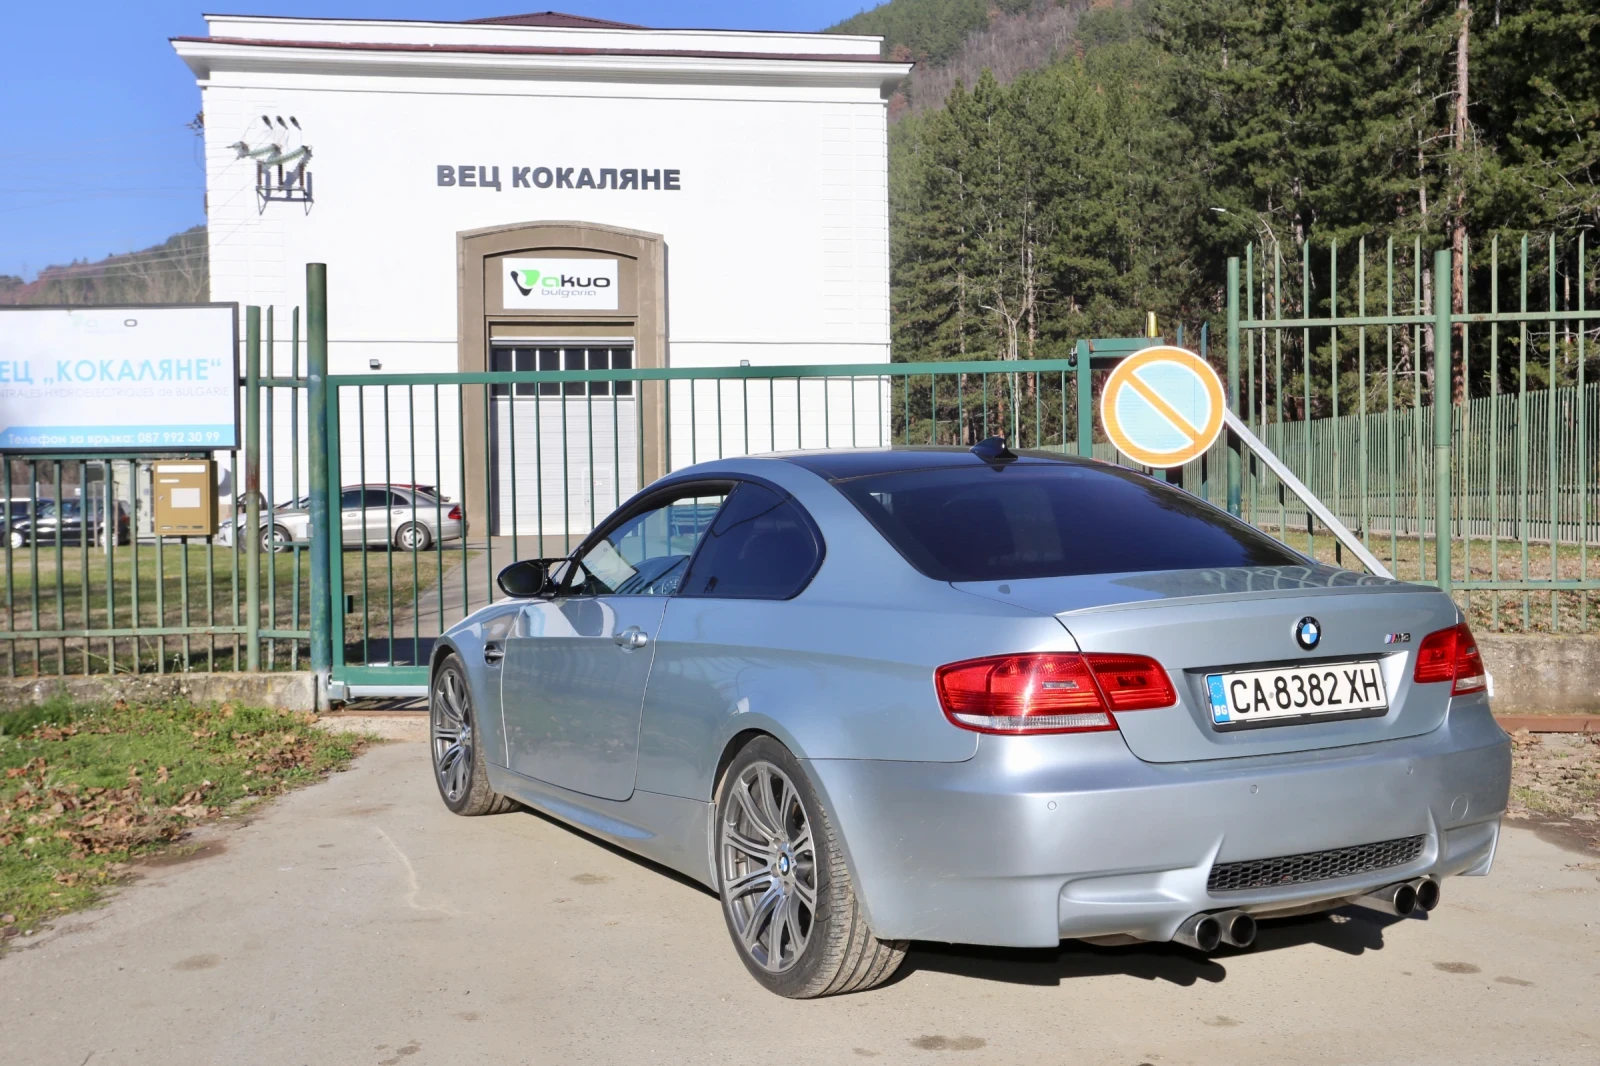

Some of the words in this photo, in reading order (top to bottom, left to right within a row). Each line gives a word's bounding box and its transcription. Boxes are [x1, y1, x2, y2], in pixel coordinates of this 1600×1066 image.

[436, 164, 502, 192] ВЕЦ
[511, 166, 682, 191] КОКАЛЯНЕ
[541, 274, 611, 288] akuo
[541, 288, 597, 298] bulgaria
[158, 386, 173, 397] de
[176, 386, 229, 397] BULGARIE
[69, 435, 85, 444] за
[138, 432, 159, 443] 087
[163, 432, 184, 443] 992
[187, 432, 203, 443] 30
[205, 431, 220, 442] 99
[1230, 677, 1270, 713] CA
[1274, 671, 1342, 709] 8382
[1343, 668, 1381, 703] XH
[1214, 704, 1228, 716] BG
